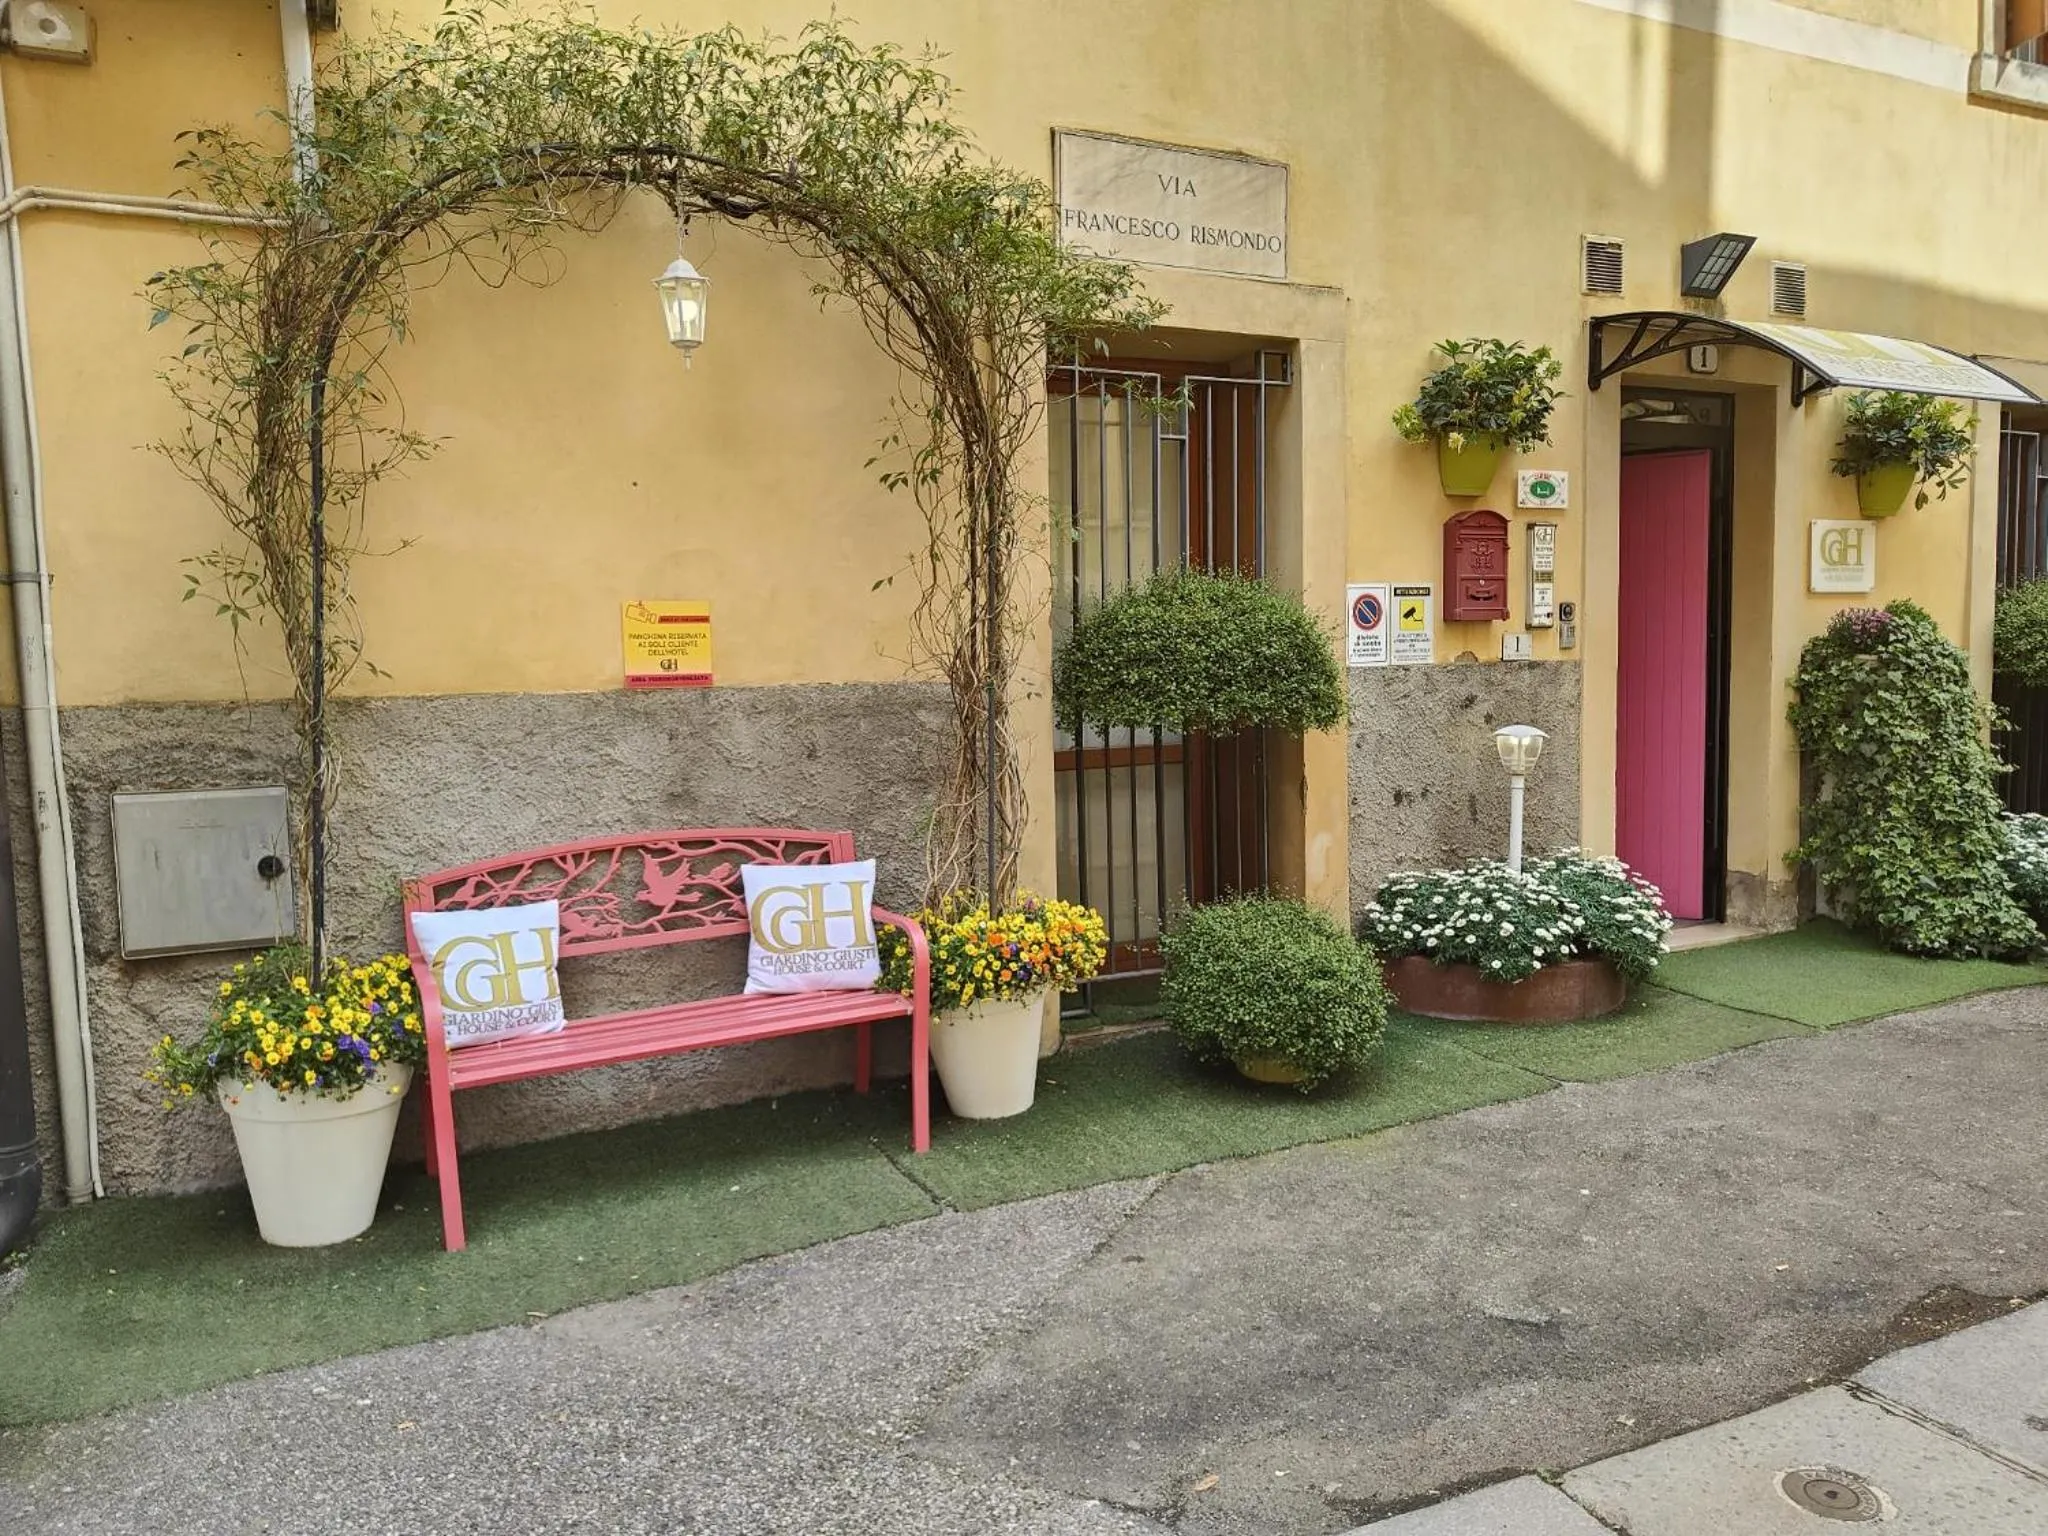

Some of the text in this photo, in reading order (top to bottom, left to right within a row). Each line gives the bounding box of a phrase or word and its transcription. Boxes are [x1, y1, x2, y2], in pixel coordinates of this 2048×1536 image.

[1158, 174, 1197, 197] VIA
[1063, 208, 1282, 253] FRANCESCO RISMONDO
[760, 947, 876, 967] GIARDINO GIUSTI
[773, 960, 864, 976] HOUSE & COURT
[457, 1022, 501, 1036] HOUSE
[517, 1012, 558, 1027] COURT
